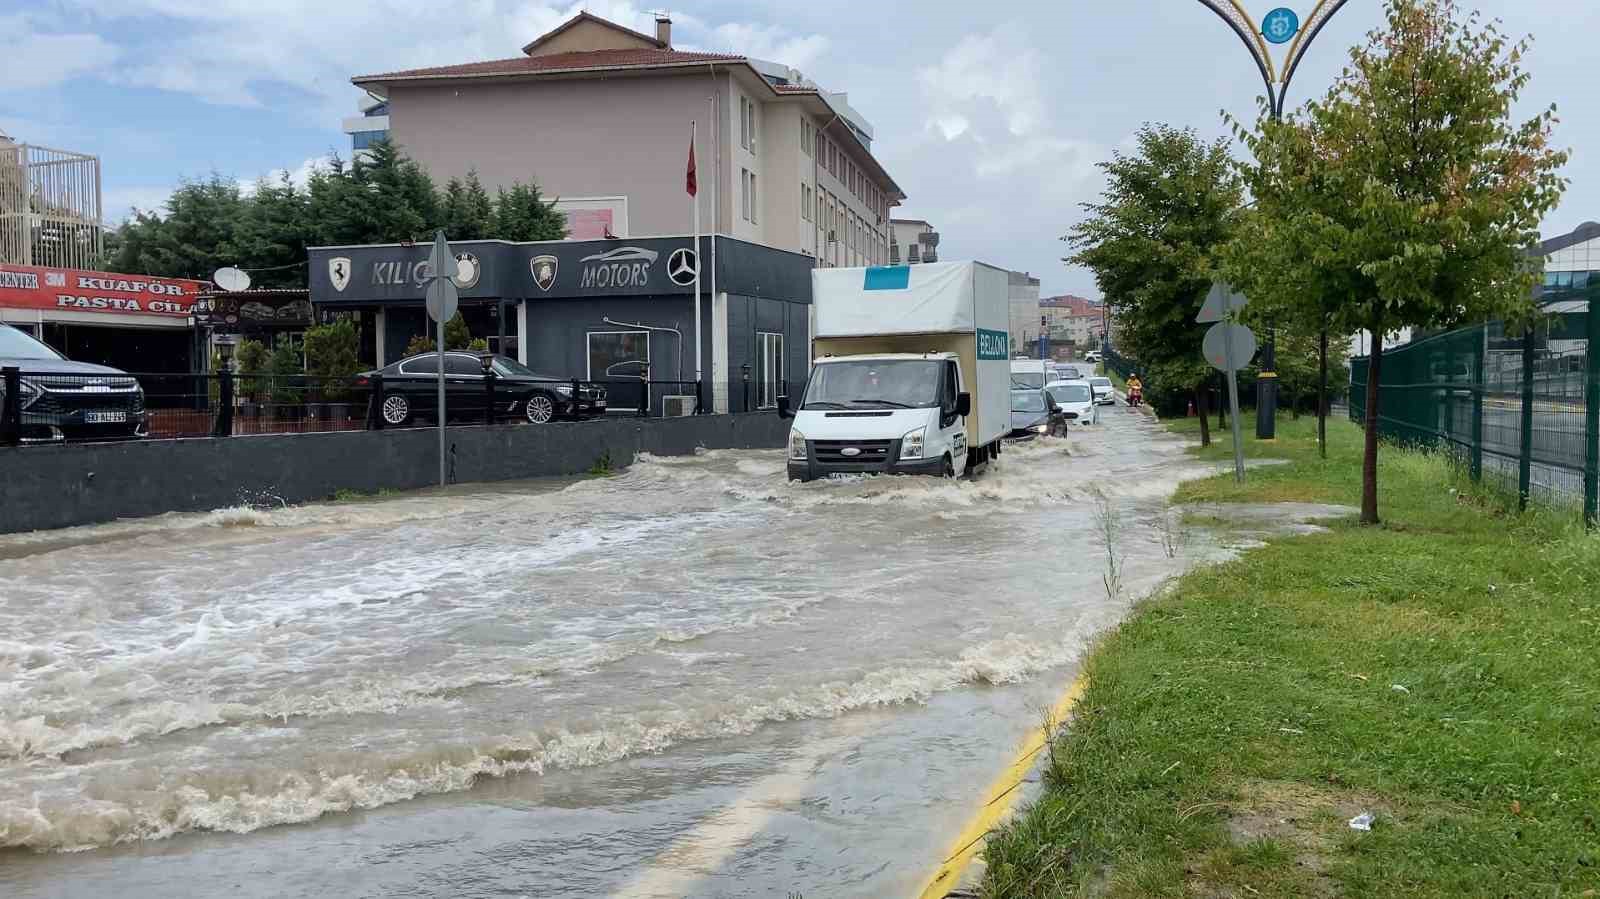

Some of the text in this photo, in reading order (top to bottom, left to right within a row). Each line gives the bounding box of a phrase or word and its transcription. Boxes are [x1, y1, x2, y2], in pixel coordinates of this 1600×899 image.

[46, 272, 66, 288] 3M
[581, 263, 650, 288] MOTORS
[78, 277, 184, 296] KUAFÖR
[57, 294, 141, 311] PASTA
